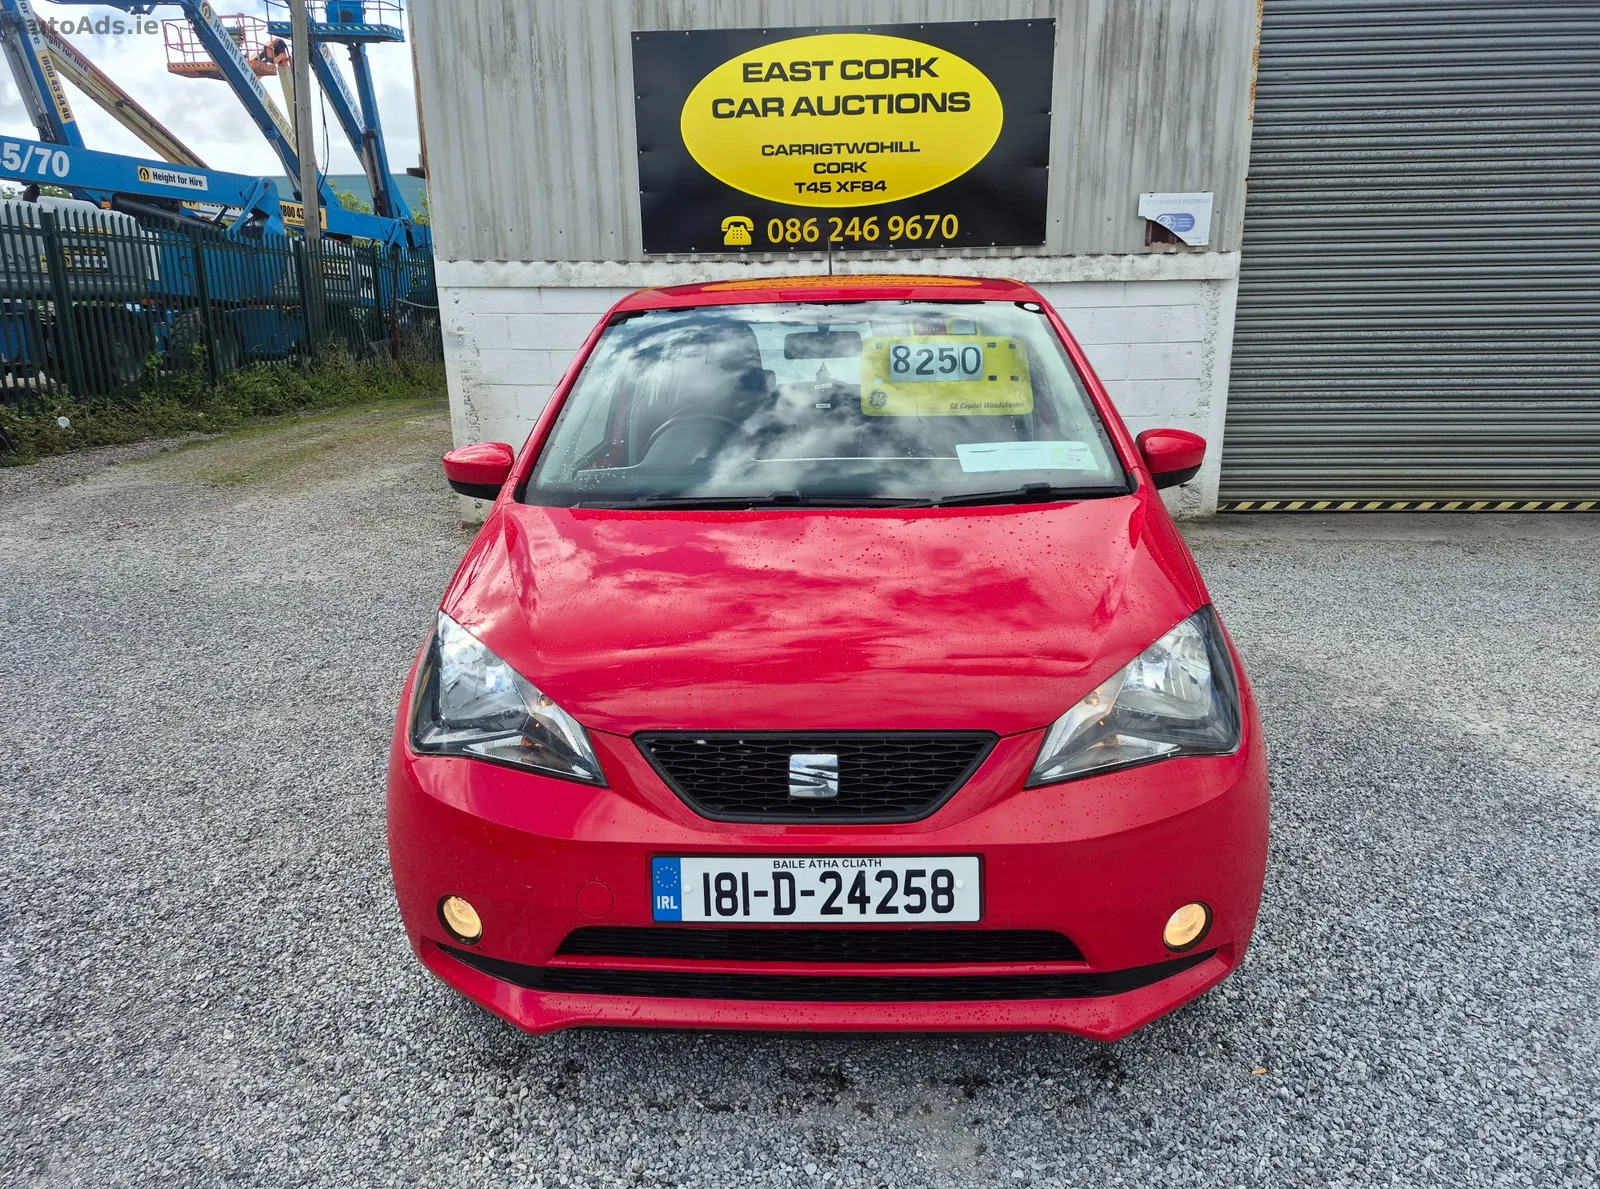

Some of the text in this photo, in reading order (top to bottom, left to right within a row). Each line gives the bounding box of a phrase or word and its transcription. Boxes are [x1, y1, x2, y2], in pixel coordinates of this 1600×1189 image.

[20, 0, 40, 44] or Hire
[213, 19, 264, 98] Height for Hire
[743, 57, 940, 84] EAST CORK
[41, 55, 55, 78] 1800
[51, 77, 60, 92] 43
[56, 92, 65, 105] 44
[712, 91, 972, 119] CAR AUCTIONS
[761, 141, 921, 157] CARRIGTWOHILL
[152, 171, 204, 187] Height for Hire
[813, 161, 868, 175] CORK
[794, 180, 887, 195] T45 XF84
[767, 213, 960, 244] 086 246 9670
[892, 345, 982, 375] 8250
[950, 402, 959, 410] GE
[960, 402, 982, 410] Capital
[773, 857, 882, 869] BAILE ÁTHA CLIATH
[656, 895, 678, 910] IRL
[702, 868, 955, 917] 181-D-24258
